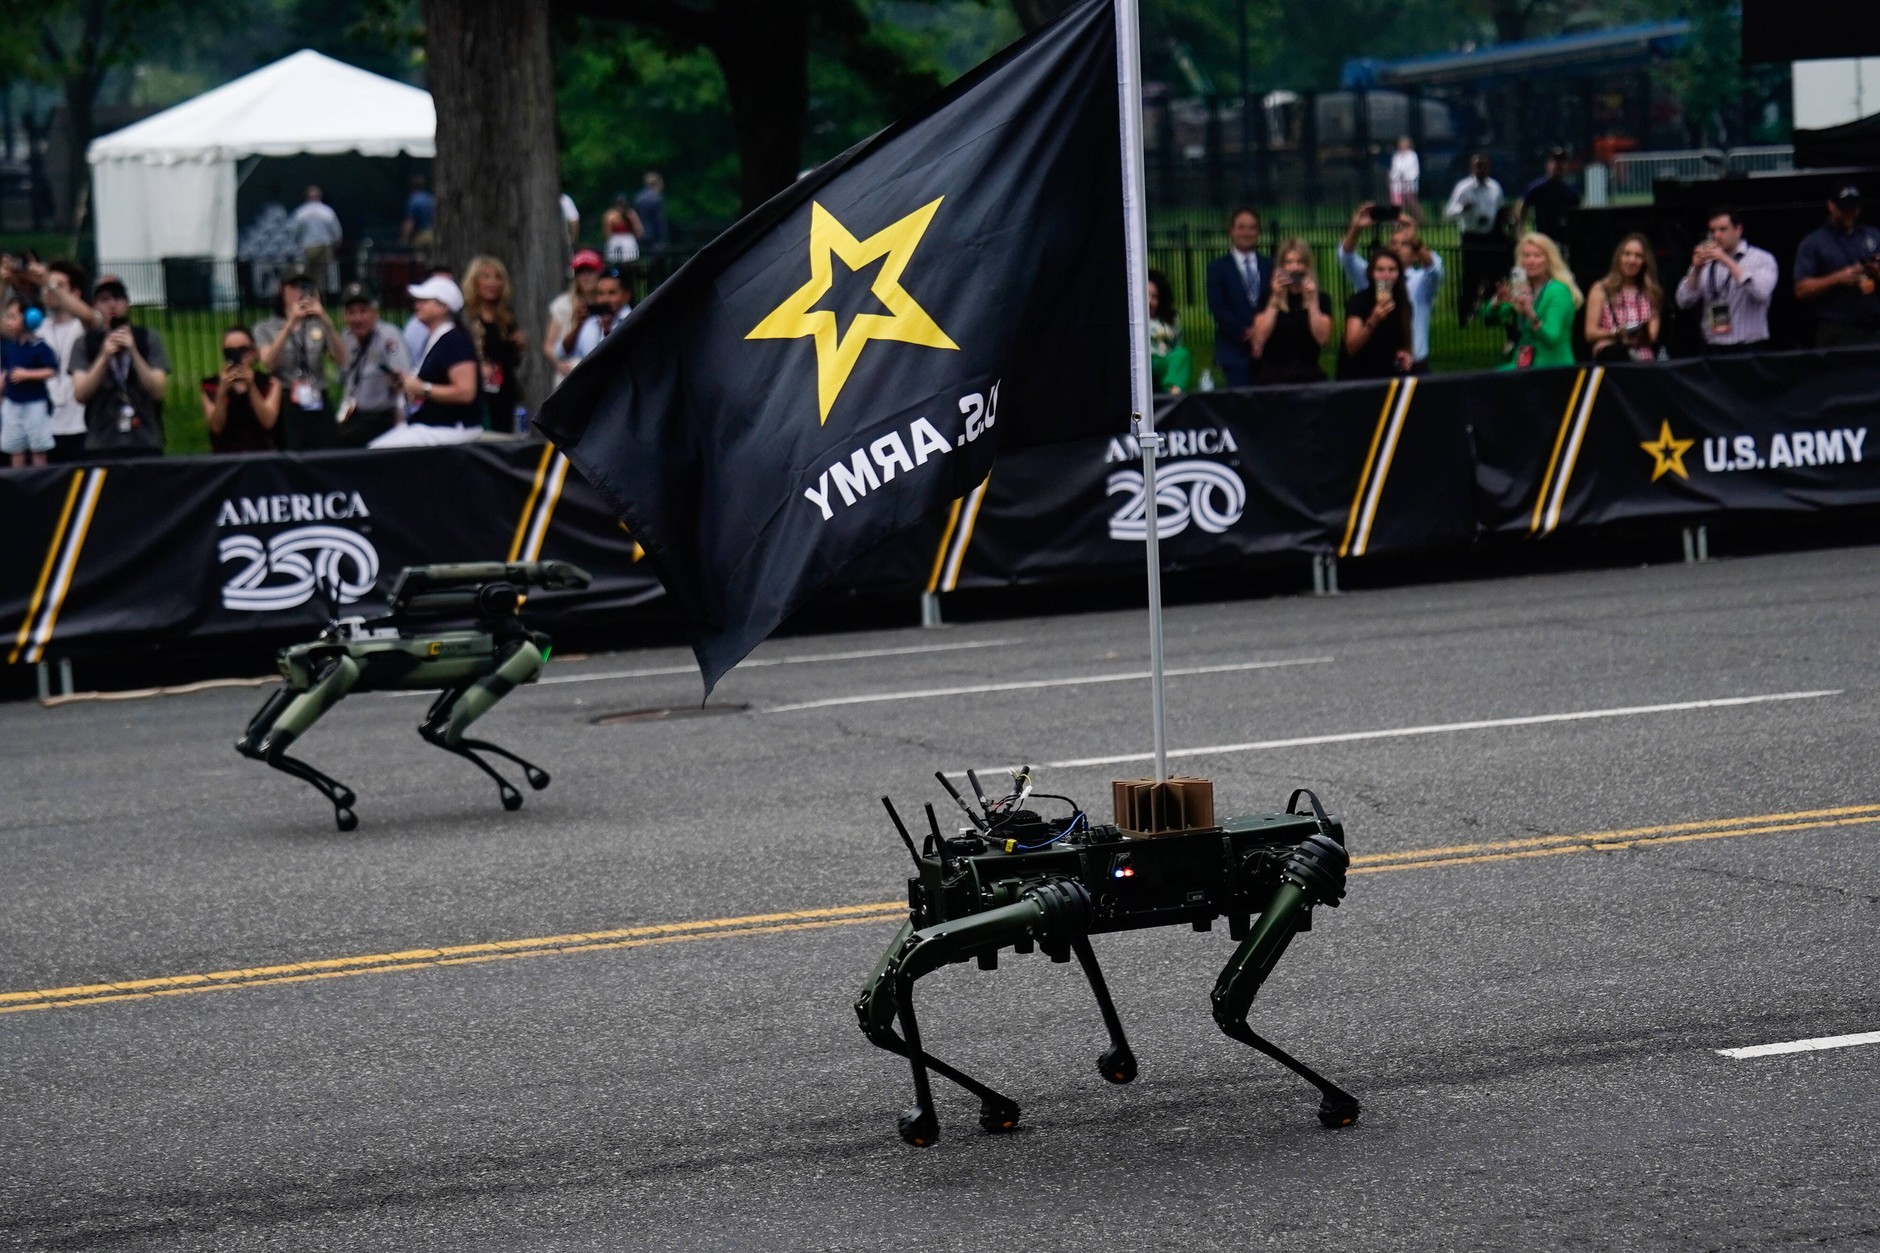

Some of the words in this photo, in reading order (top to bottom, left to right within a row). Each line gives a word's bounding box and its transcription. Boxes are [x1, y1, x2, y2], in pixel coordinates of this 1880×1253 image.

[1703, 435, 1766, 472] U.S.
[1769, 427, 1867, 468] ARMY
[216, 491, 370, 526] AMERICA
[1106, 460, 1246, 540] 250
[218, 525, 379, 611] 250
